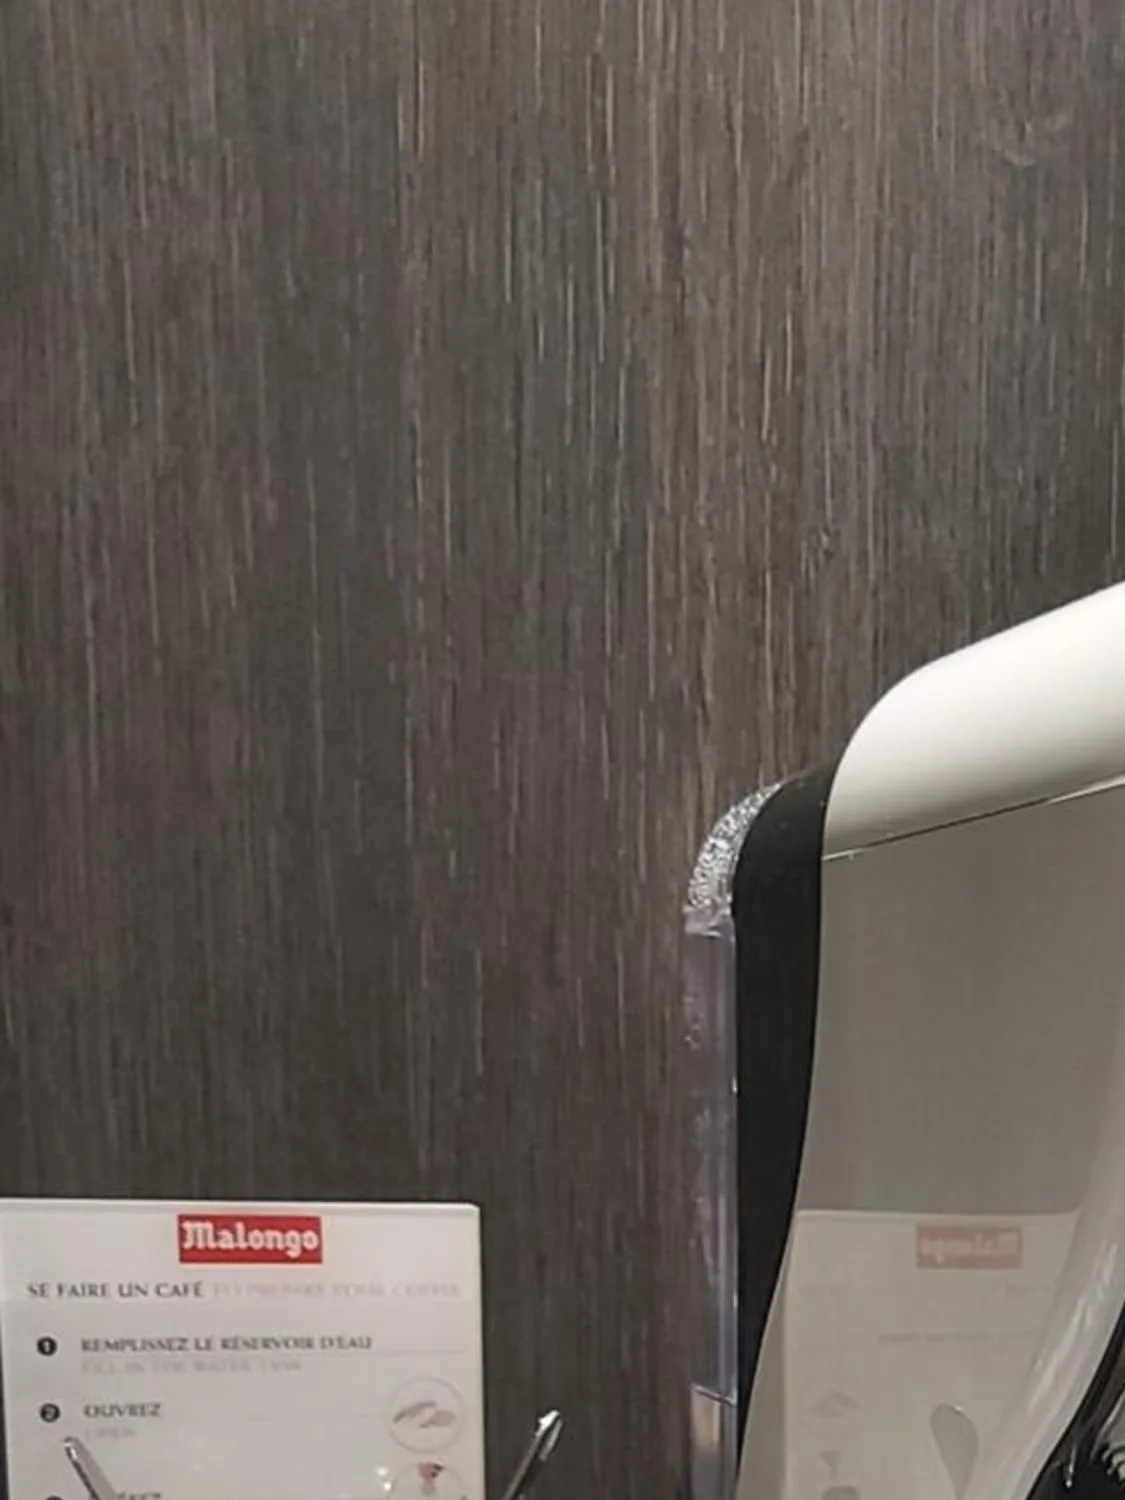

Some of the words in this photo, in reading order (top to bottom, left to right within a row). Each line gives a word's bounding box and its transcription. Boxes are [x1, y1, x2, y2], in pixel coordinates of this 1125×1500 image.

[182, 1220, 319, 1258] Malongo
[27, 1281, 49, 1297] SE
[57, 1281, 109, 1297] FAIRE
[118, 1281, 149, 1297] UN
[155, 1279, 203, 1297] CAFÉ
[81, 1337, 189, 1352] REMPLISSEZ
[194, 1336, 212, 1351] LE
[84, 1403, 161, 1418] OUVREZ
